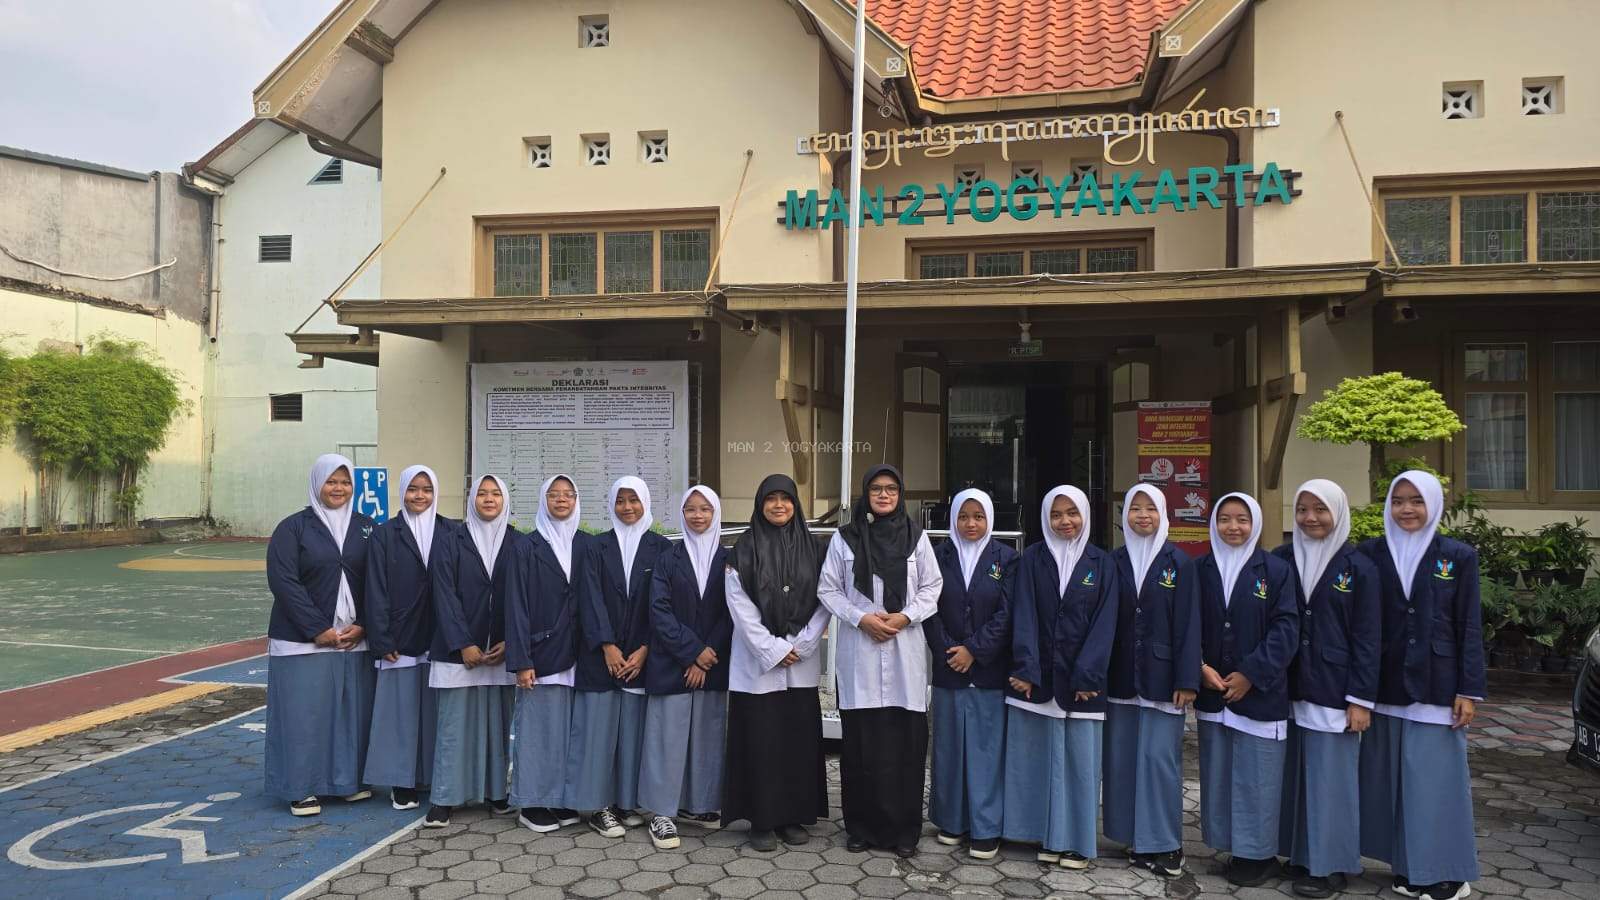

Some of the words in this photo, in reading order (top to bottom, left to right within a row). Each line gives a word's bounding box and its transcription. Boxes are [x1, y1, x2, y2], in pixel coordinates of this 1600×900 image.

[785, 184, 885, 230] MAN
[897, 182, 926, 226] 2
[936, 161, 1293, 226] YOGYAKARTA
[551, 379, 609, 387] DEKLARASI
[377, 471, 386, 488] P
